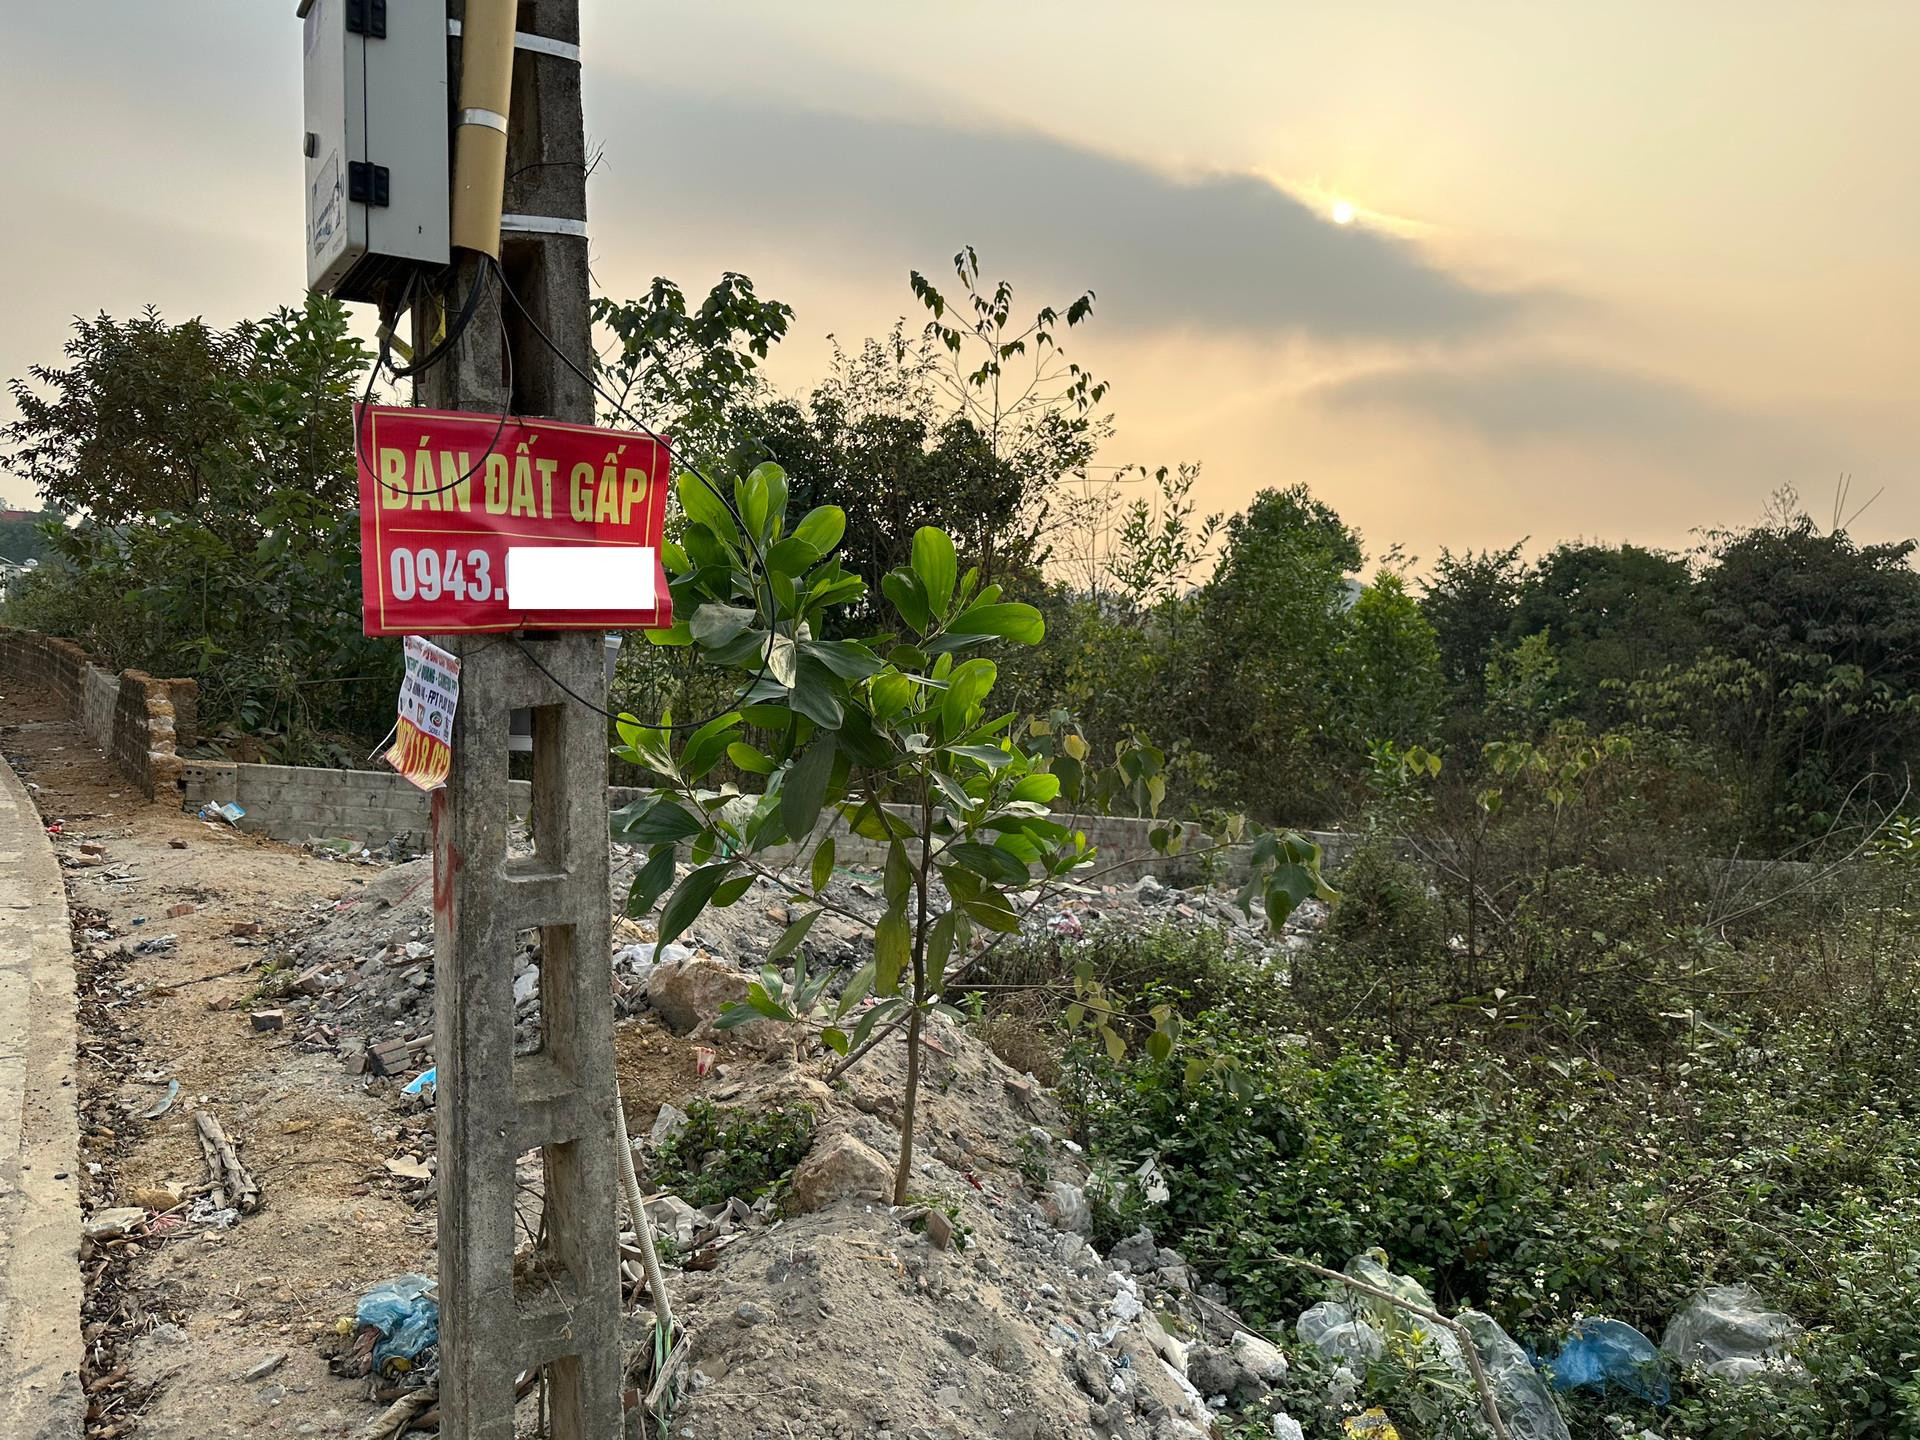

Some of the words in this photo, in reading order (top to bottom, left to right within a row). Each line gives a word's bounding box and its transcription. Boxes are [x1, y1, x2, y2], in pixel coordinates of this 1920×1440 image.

[380, 435, 472, 513] BÁN
[484, 435, 559, 519] ĐẤT
[570, 444, 647, 525] GẤP
[389, 547, 509, 601] 0943.
[427, 690, 439, 706] FPT
